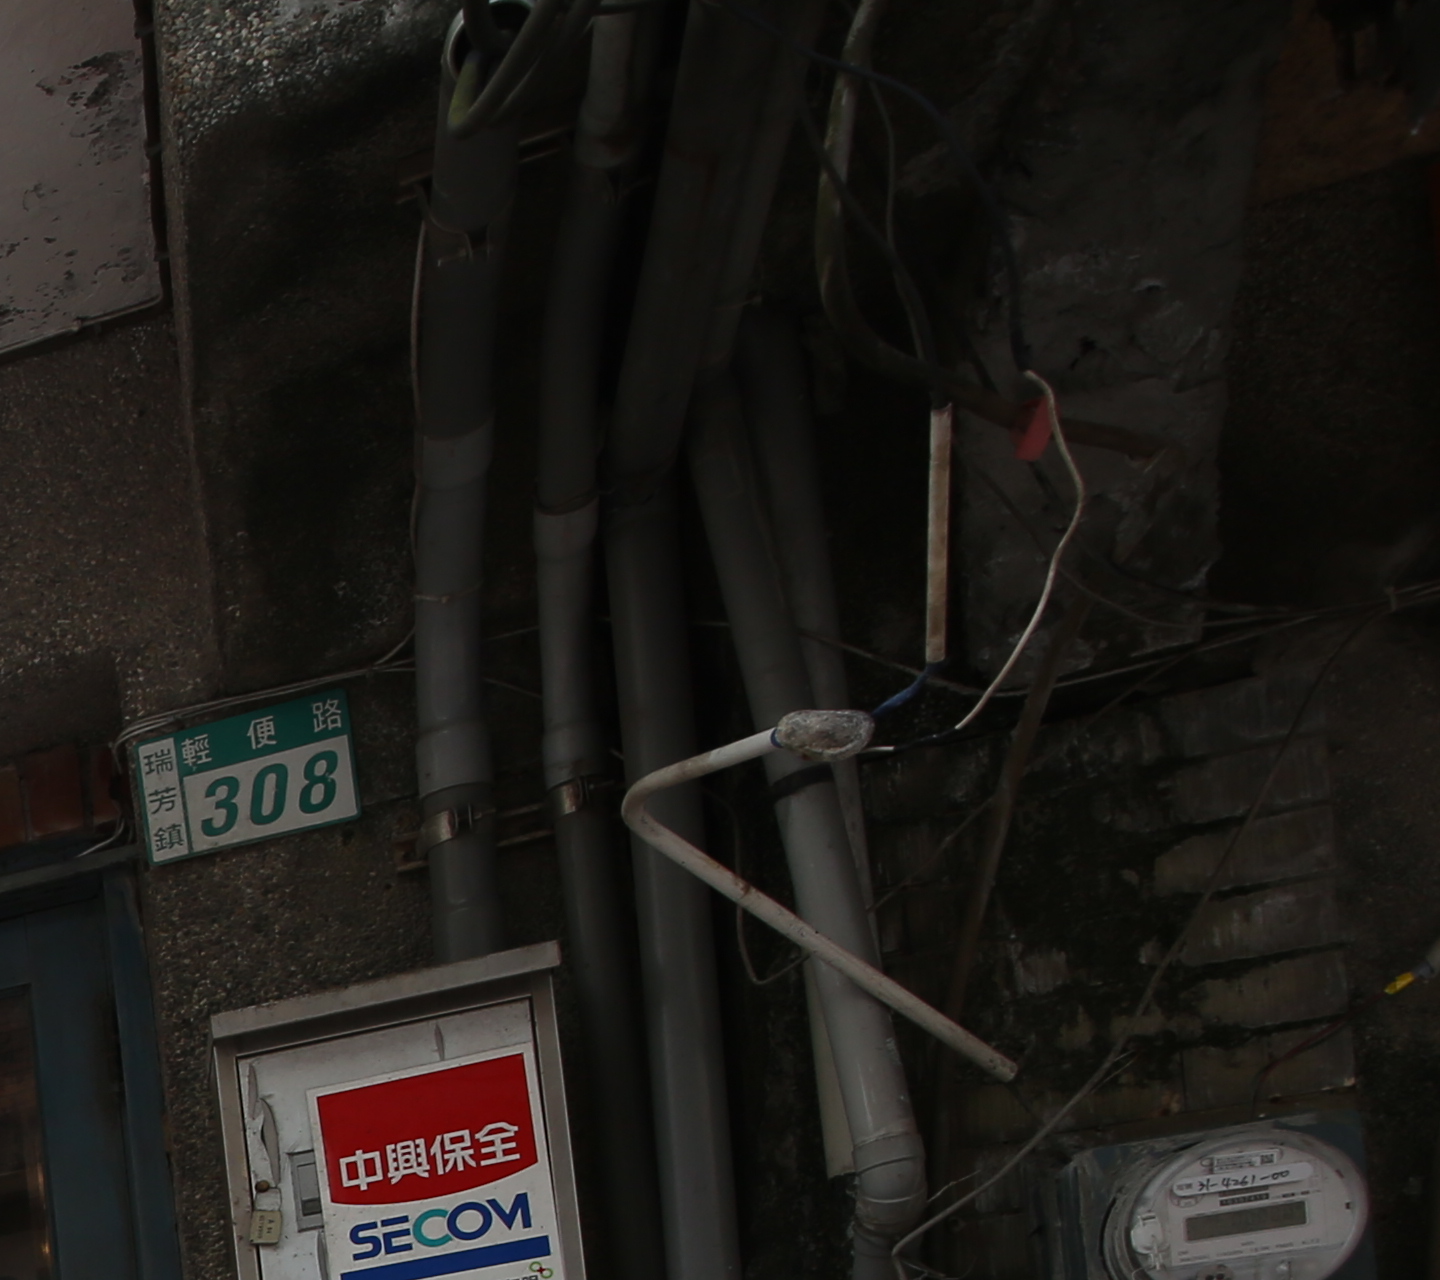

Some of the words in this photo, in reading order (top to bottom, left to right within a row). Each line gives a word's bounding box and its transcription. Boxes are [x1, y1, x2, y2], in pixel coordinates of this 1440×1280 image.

[181, 699, 341, 766] 輕便路
[143, 749, 185, 852] 瑞芳鎮
[201, 750, 338, 837] 308
[339, 1121, 522, 1191] 中興保全
[349, 1192, 532, 1262] SECOM
